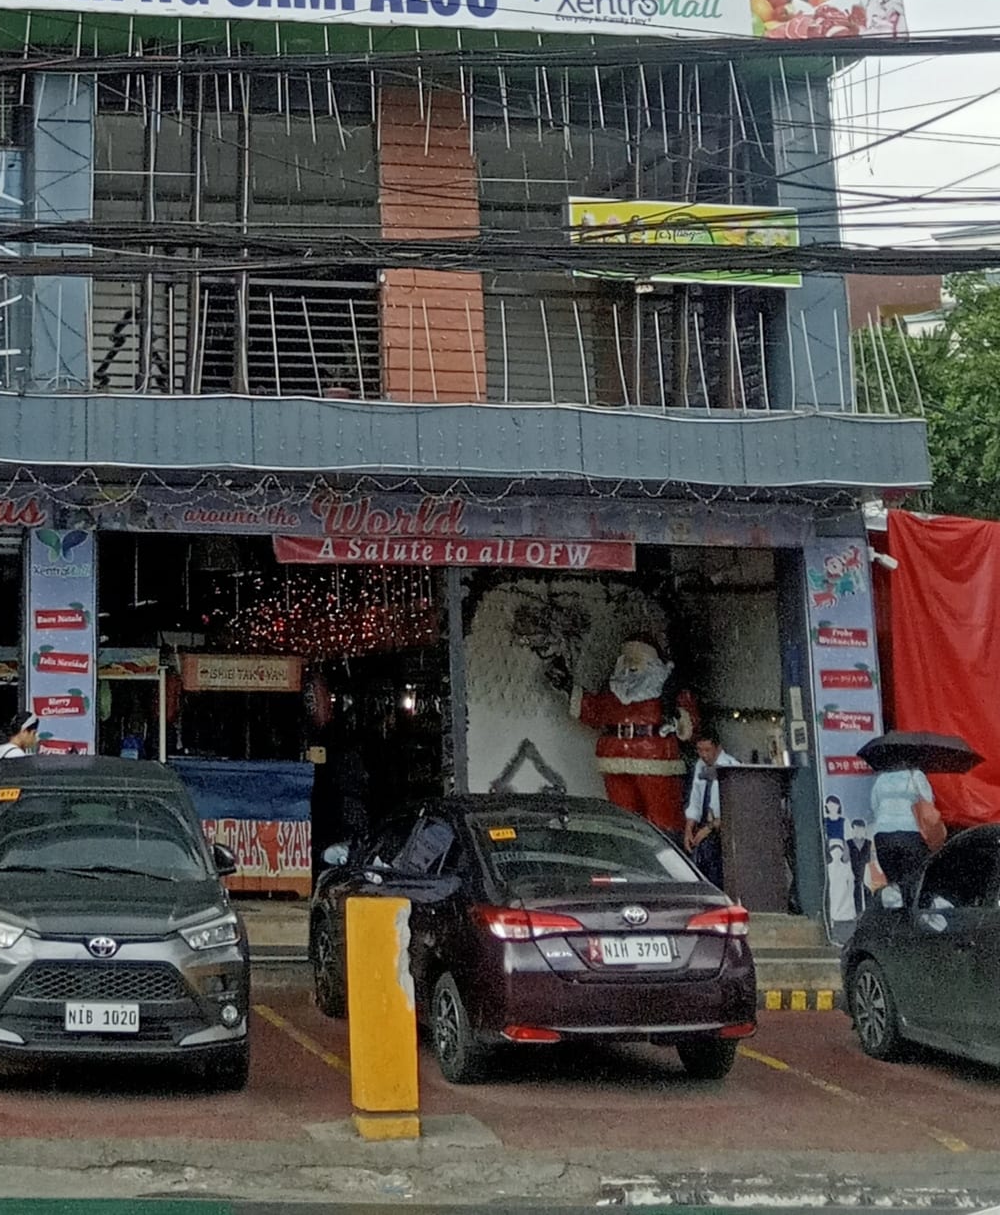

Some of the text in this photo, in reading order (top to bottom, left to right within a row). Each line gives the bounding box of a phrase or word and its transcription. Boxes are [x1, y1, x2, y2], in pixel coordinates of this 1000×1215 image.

[266, 505, 299, 527] the
[310, 492, 468, 537] World
[317, 538, 593, 568] A Salute to all OFW
[48, 697, 71, 707] Merry
[41, 707, 80, 716] Christmas
[603, 942, 670, 958] NIH 3790
[68, 1009, 137, 1026] NIB 1020
